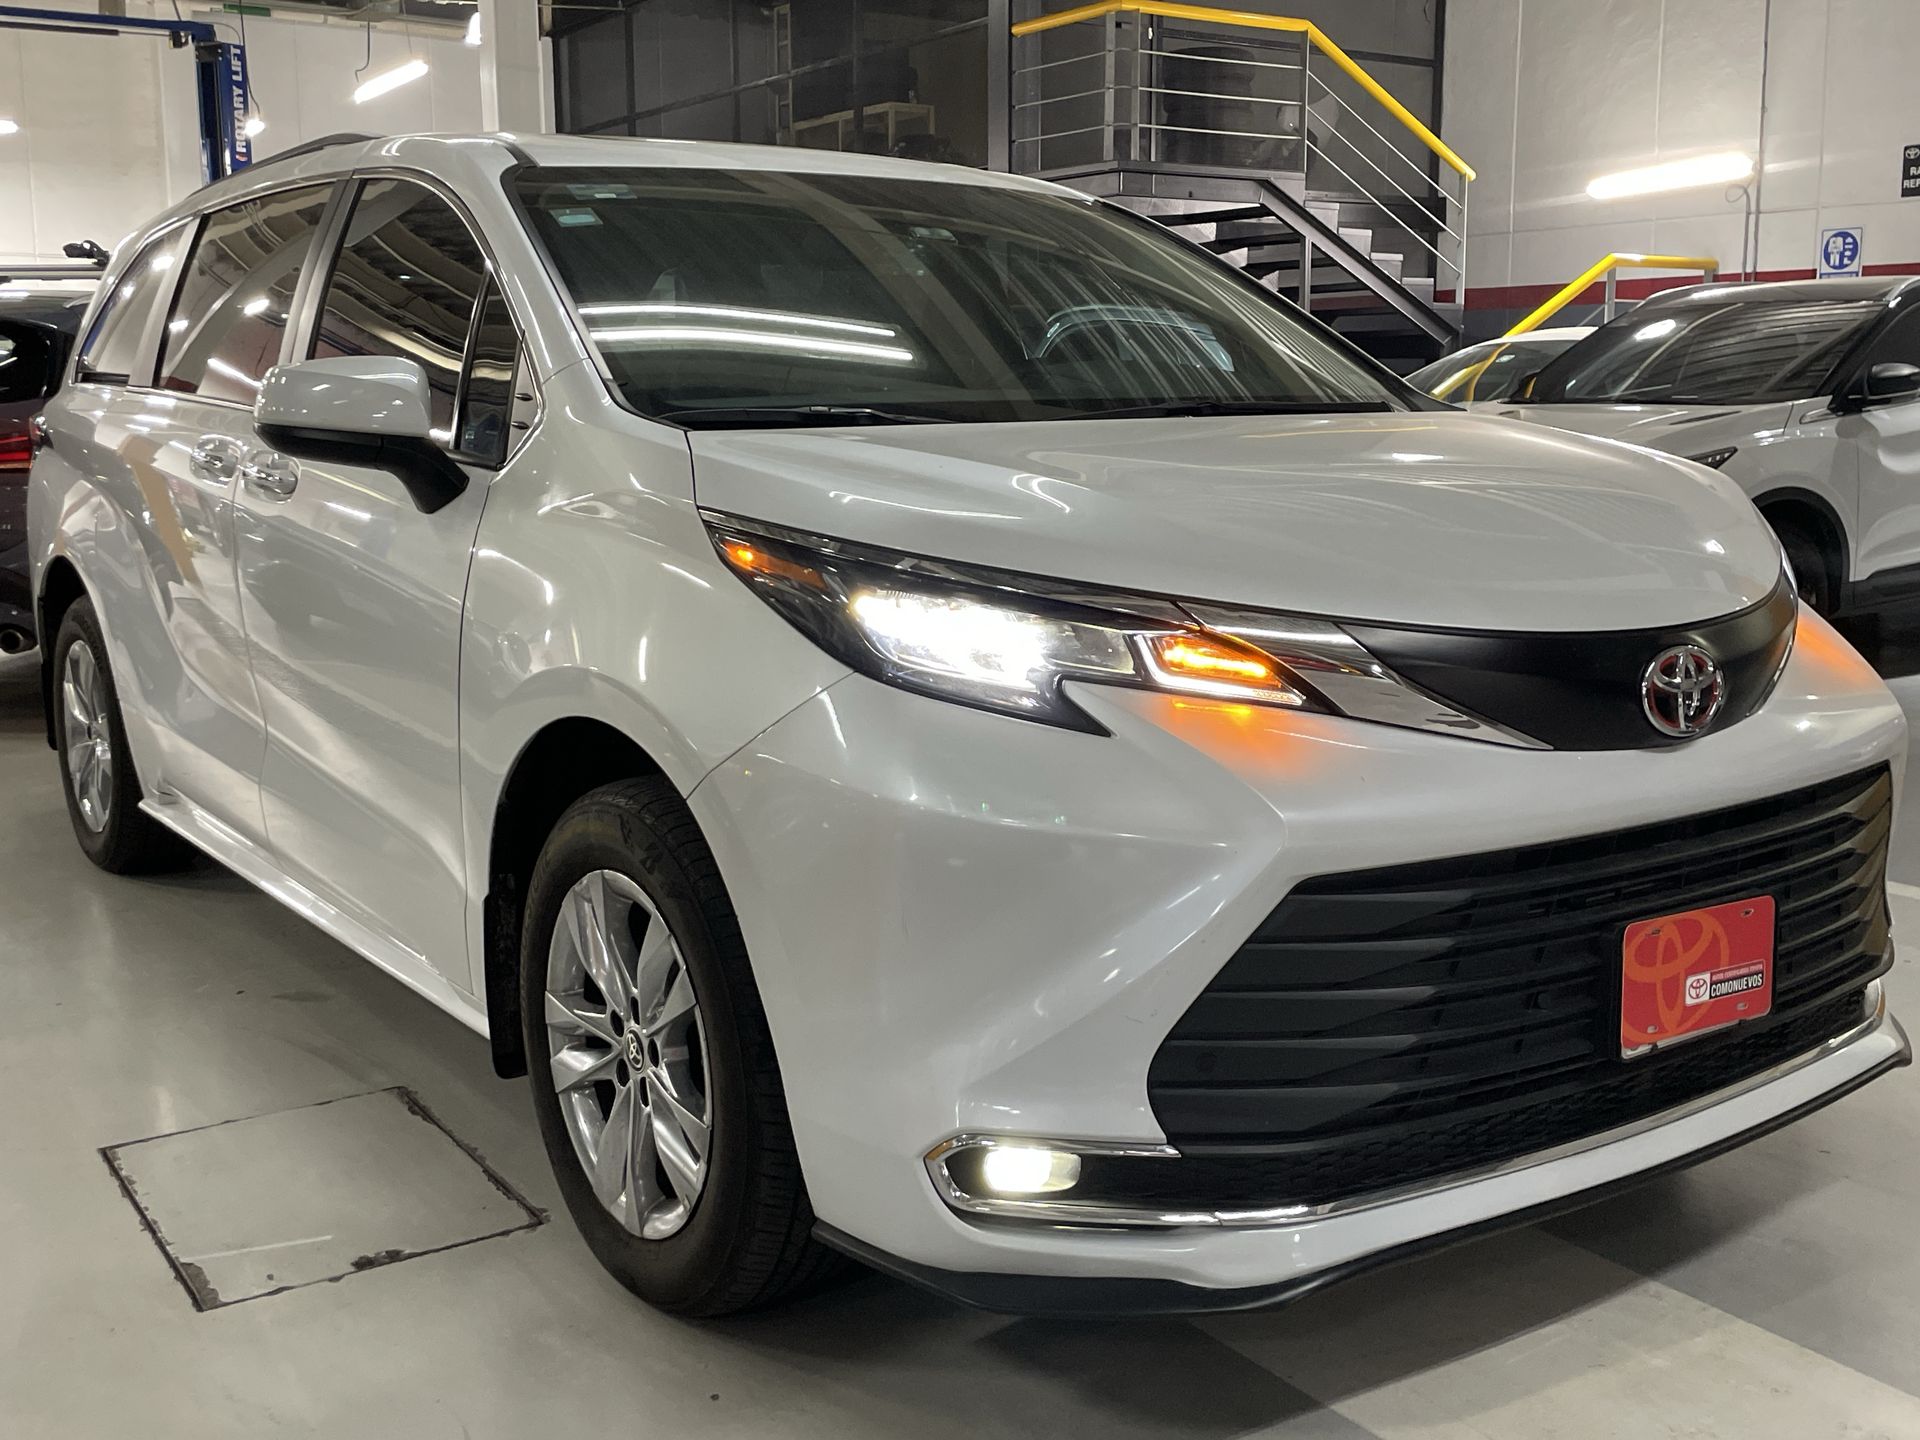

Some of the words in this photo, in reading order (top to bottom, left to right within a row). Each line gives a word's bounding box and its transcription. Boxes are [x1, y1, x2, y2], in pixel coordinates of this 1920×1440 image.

[231, 46, 242, 82] LIFT
[233, 86, 246, 153] ROTARY
[1711, 974, 1762, 997] COMONUEVOS
